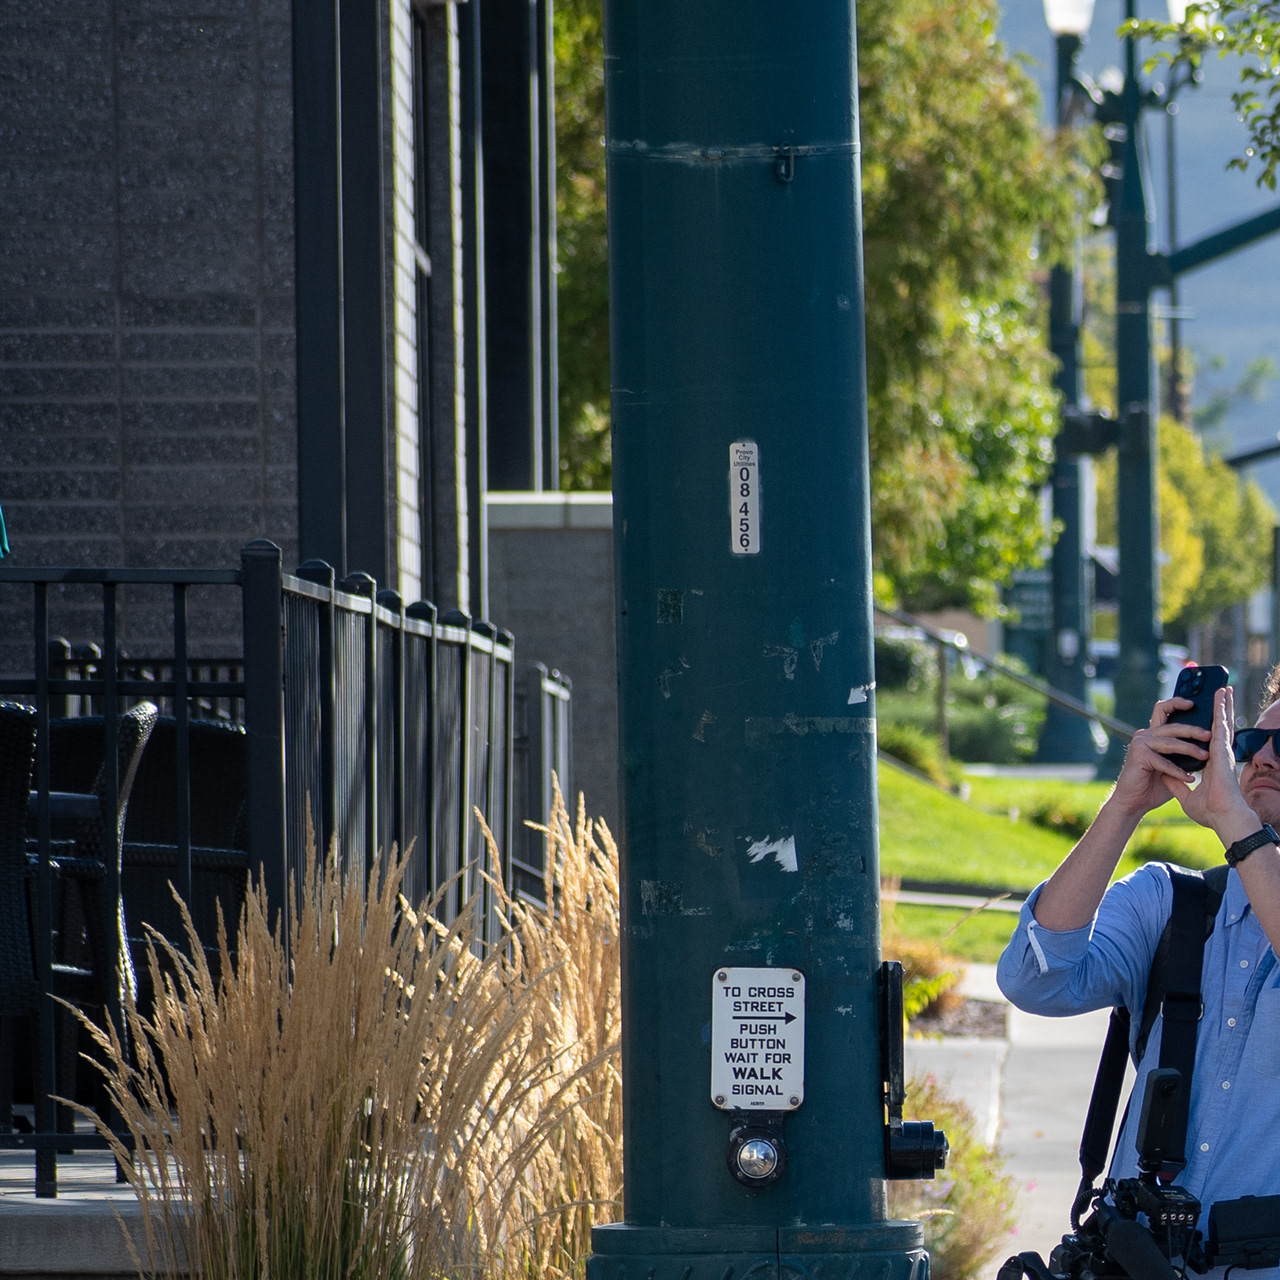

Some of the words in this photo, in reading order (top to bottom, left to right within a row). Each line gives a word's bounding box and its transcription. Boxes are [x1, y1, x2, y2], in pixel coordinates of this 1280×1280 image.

[723, 986, 741, 998] TO
[748, 986, 795, 998] CROSS
[733, 1001, 784, 1012] STREET
[739, 1024, 777, 1035] PUSH
[730, 1038, 786, 1050] BUTTON
[724, 1053, 759, 1064] WAIT
[765, 1053, 792, 1064] FOR
[732, 1067, 783, 1080] WALK
[731, 1084, 784, 1096] SIGNAL
